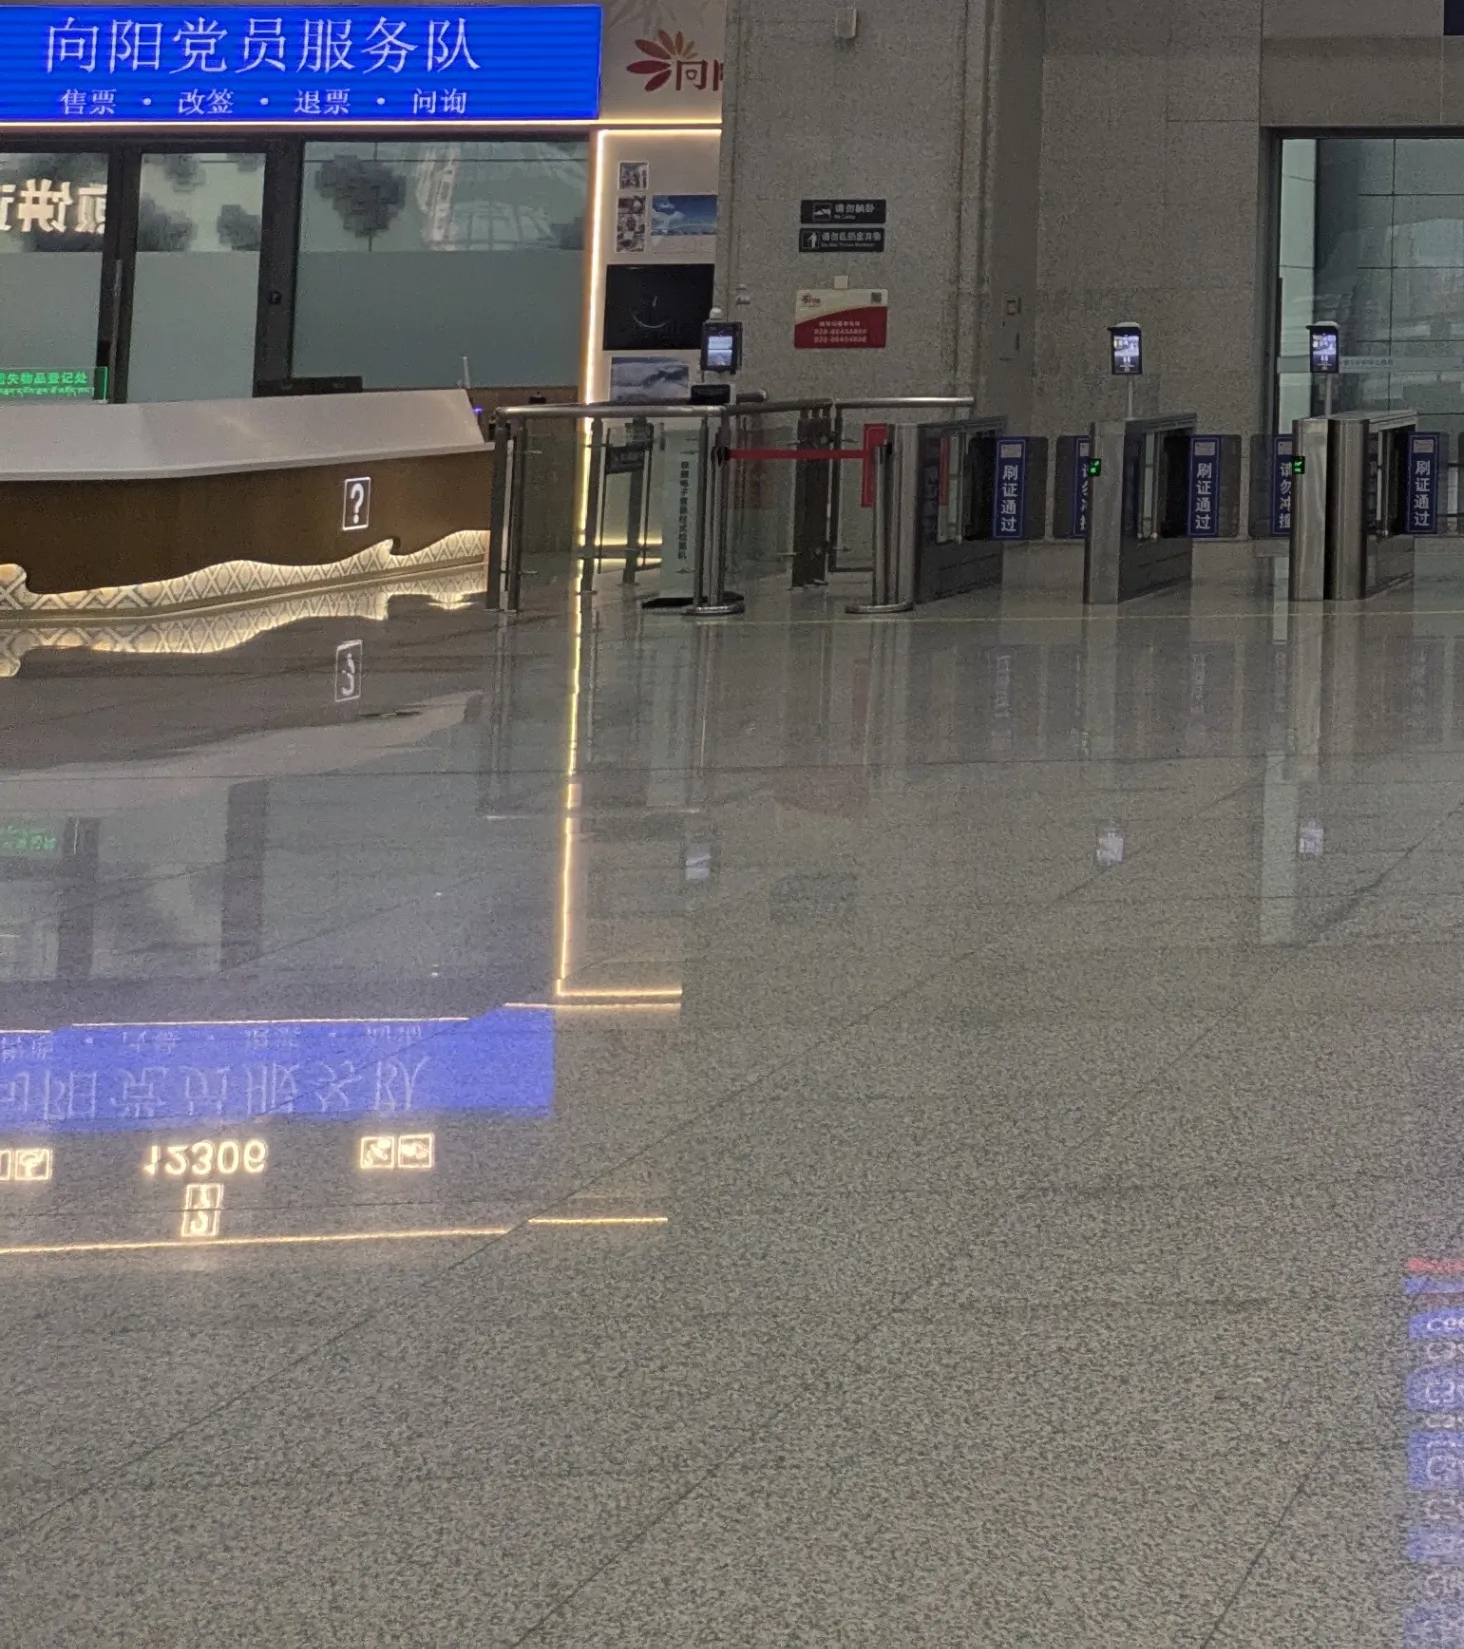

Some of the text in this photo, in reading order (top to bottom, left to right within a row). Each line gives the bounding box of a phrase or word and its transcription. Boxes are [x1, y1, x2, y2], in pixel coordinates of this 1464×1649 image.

[47, 16, 481, 74] 向阳党员服务队
[60, 88, 468, 114] 售票 改签 退票 问询
[1001, 465, 1018, 533] 刷证通过
[1196, 463, 1212, 530] 刷证通过
[1414, 459, 1430, 526] 刷证通过
